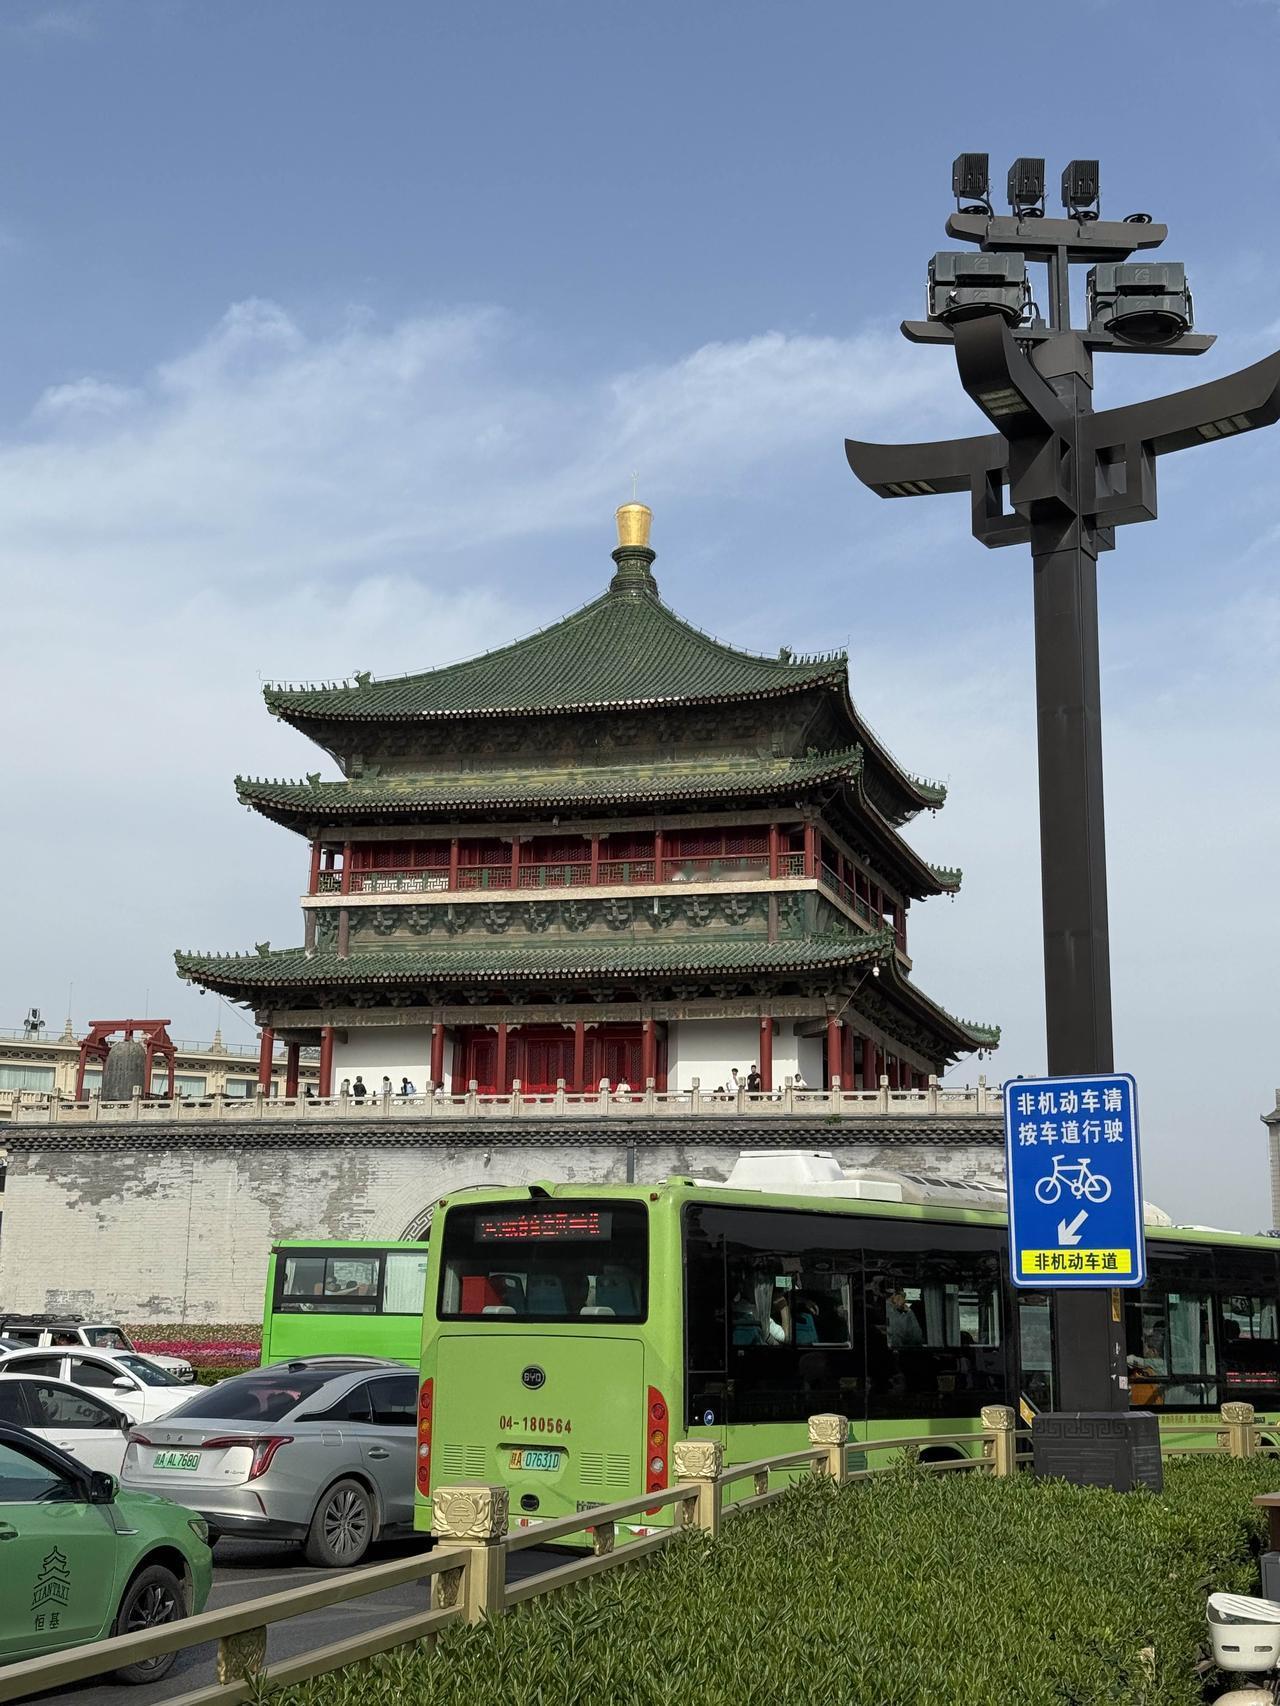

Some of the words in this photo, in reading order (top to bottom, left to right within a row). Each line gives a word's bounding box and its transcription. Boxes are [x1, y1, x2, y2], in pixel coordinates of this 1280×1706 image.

[1017, 1088, 1123, 1115] 非机动车请
[1018, 1118, 1124, 1146] 按车道行驶
[1034, 1252, 1119, 1271] 非机动车道
[523, 1372, 541, 1382] BYD
[499, 1415, 572, 1434] 04-180564
[35, 1612, 60, 1631] 恒基
